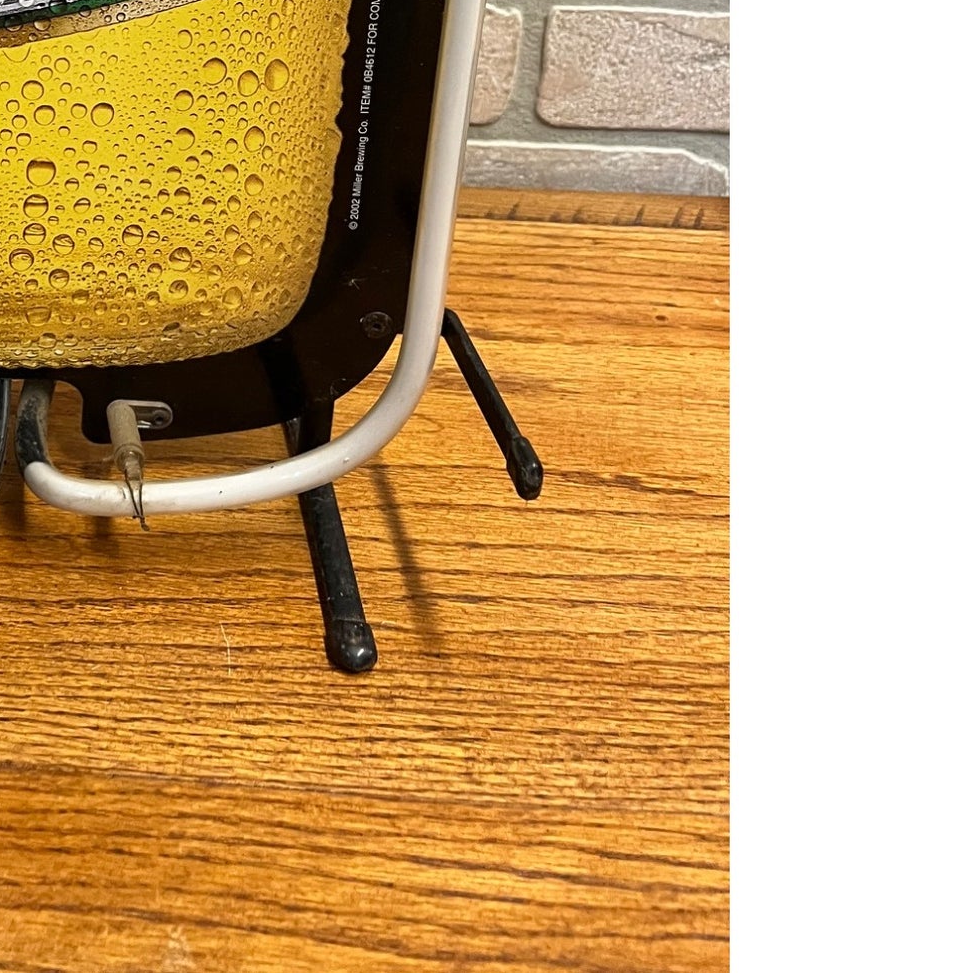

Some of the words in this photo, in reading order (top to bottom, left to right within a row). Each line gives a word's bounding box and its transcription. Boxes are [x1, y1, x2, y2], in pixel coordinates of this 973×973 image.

[367, 23, 378, 45] FOR
[360, 85, 372, 114] ITEM#
[358, 119, 369, 134] Co.
[354, 136, 369, 172] Brewing
[352, 173, 363, 197] Miller
[350, 198, 361, 220] 2002
